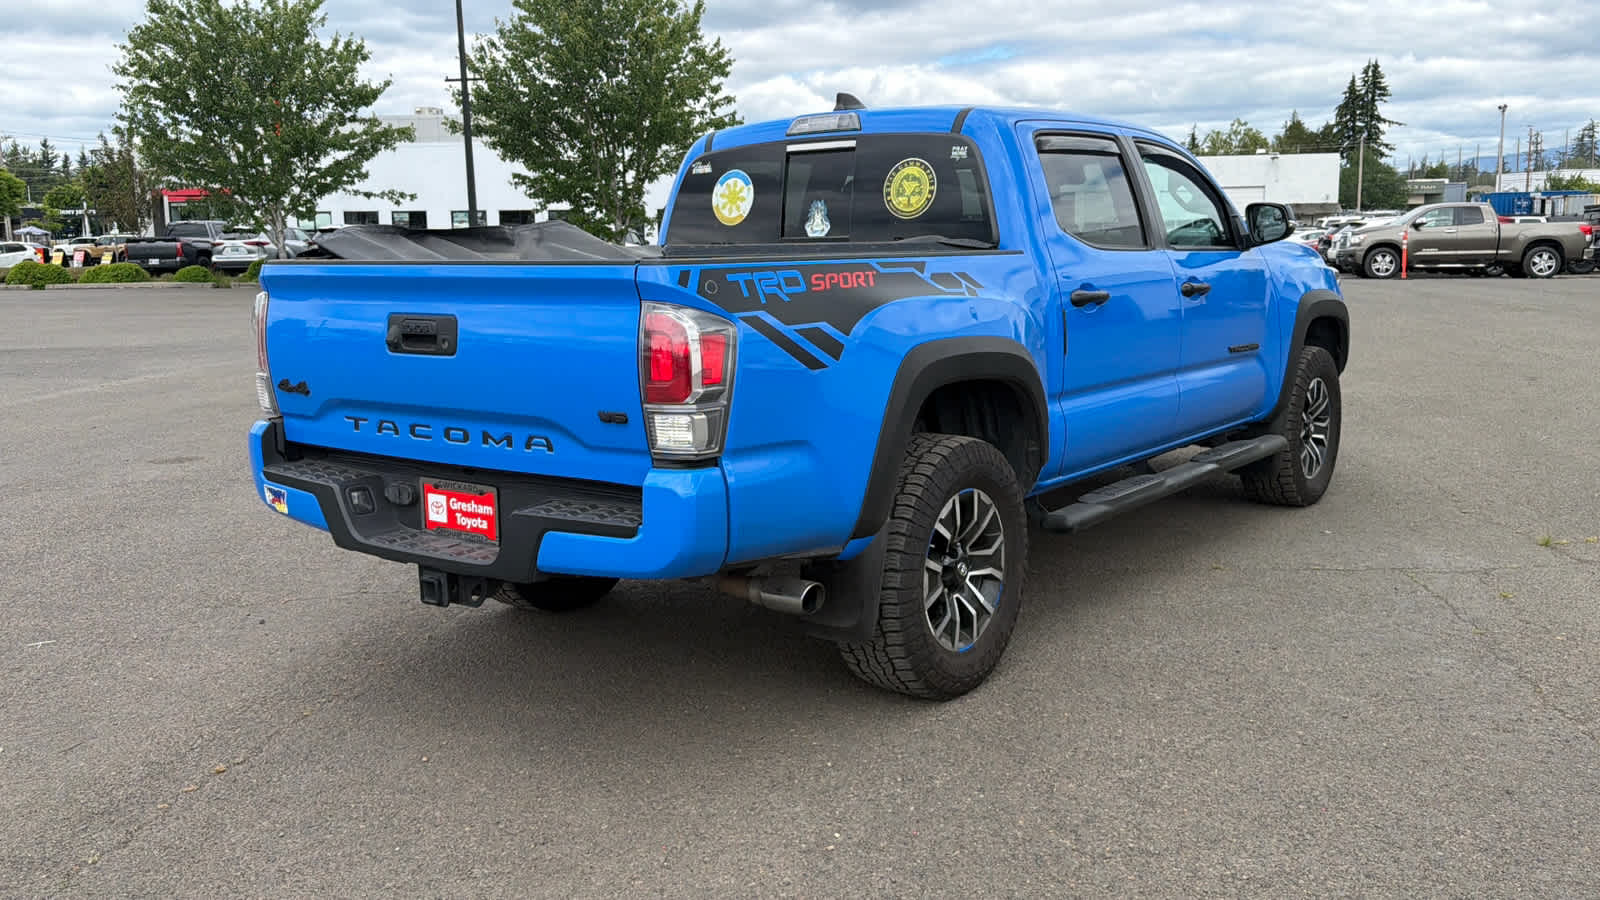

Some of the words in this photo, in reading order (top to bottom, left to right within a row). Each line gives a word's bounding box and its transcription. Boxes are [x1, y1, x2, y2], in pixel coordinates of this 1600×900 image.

[726, 269, 807, 304] TRD
[811, 271, 876, 291] SPORT
[344, 416, 555, 455] TACOMA
[449, 497, 493, 516] Gresham
[455, 513, 488, 529] Toyota
